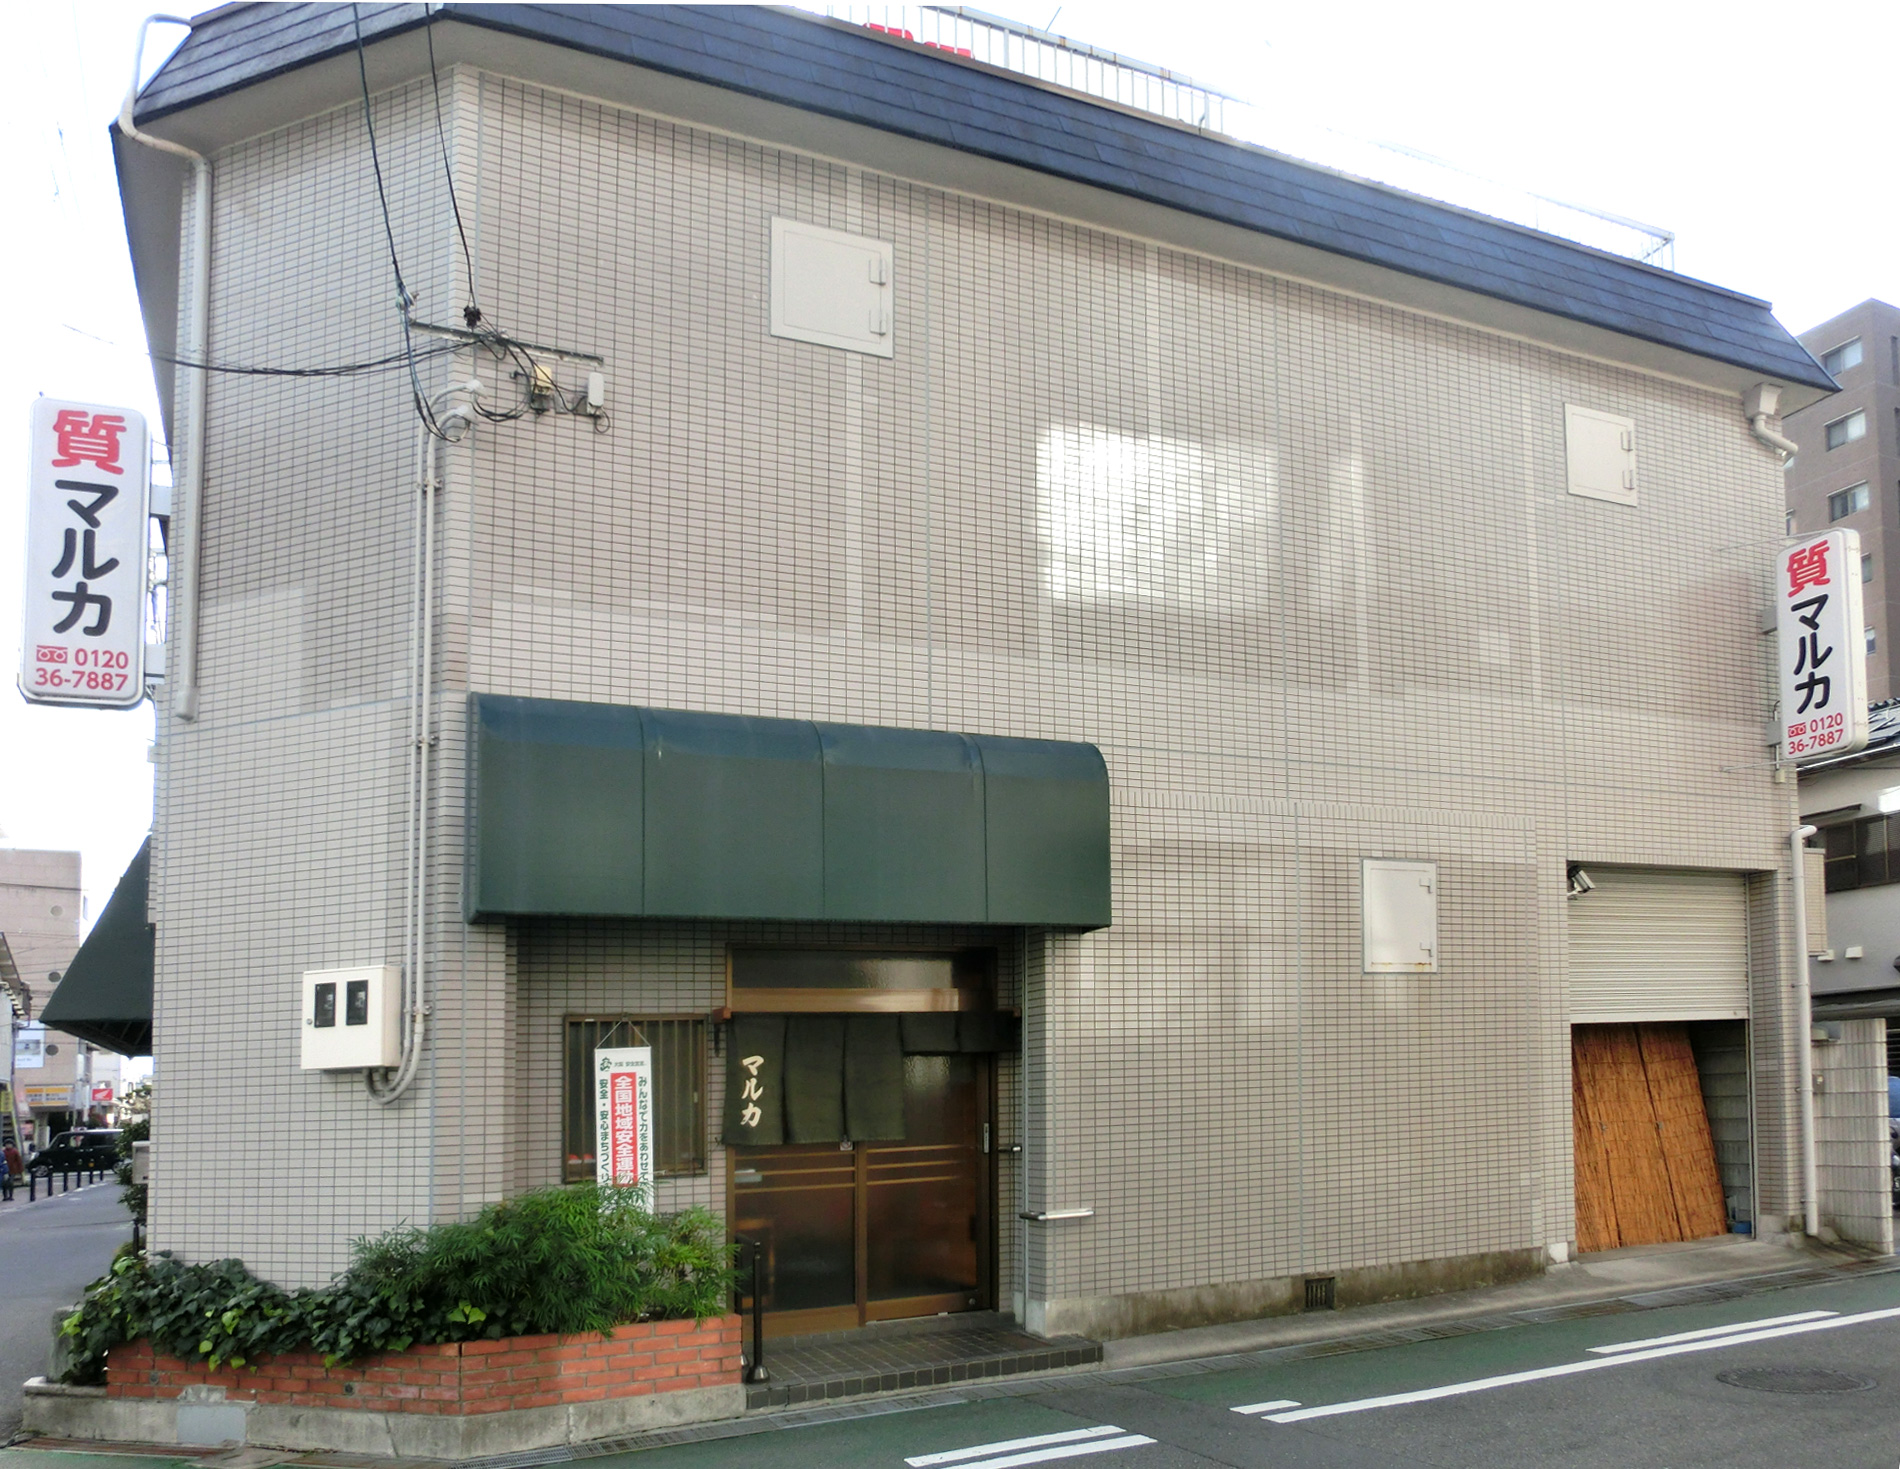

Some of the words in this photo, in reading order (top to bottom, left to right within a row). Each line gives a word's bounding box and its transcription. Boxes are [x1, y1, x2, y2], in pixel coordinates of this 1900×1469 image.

[51, 409, 127, 475] 質
[51, 479, 120, 636] マルカ
[1786, 539, 1831, 598] 質
[34, 667, 129, 691] 36-7887
[74, 648, 129, 669] 0120
[1790, 593, 1834, 715] マルカ
[1788, 728, 1844, 755] 36-7887
[1809, 712, 1843, 733] 0120
[740, 1055, 765, 1127] マルカ
